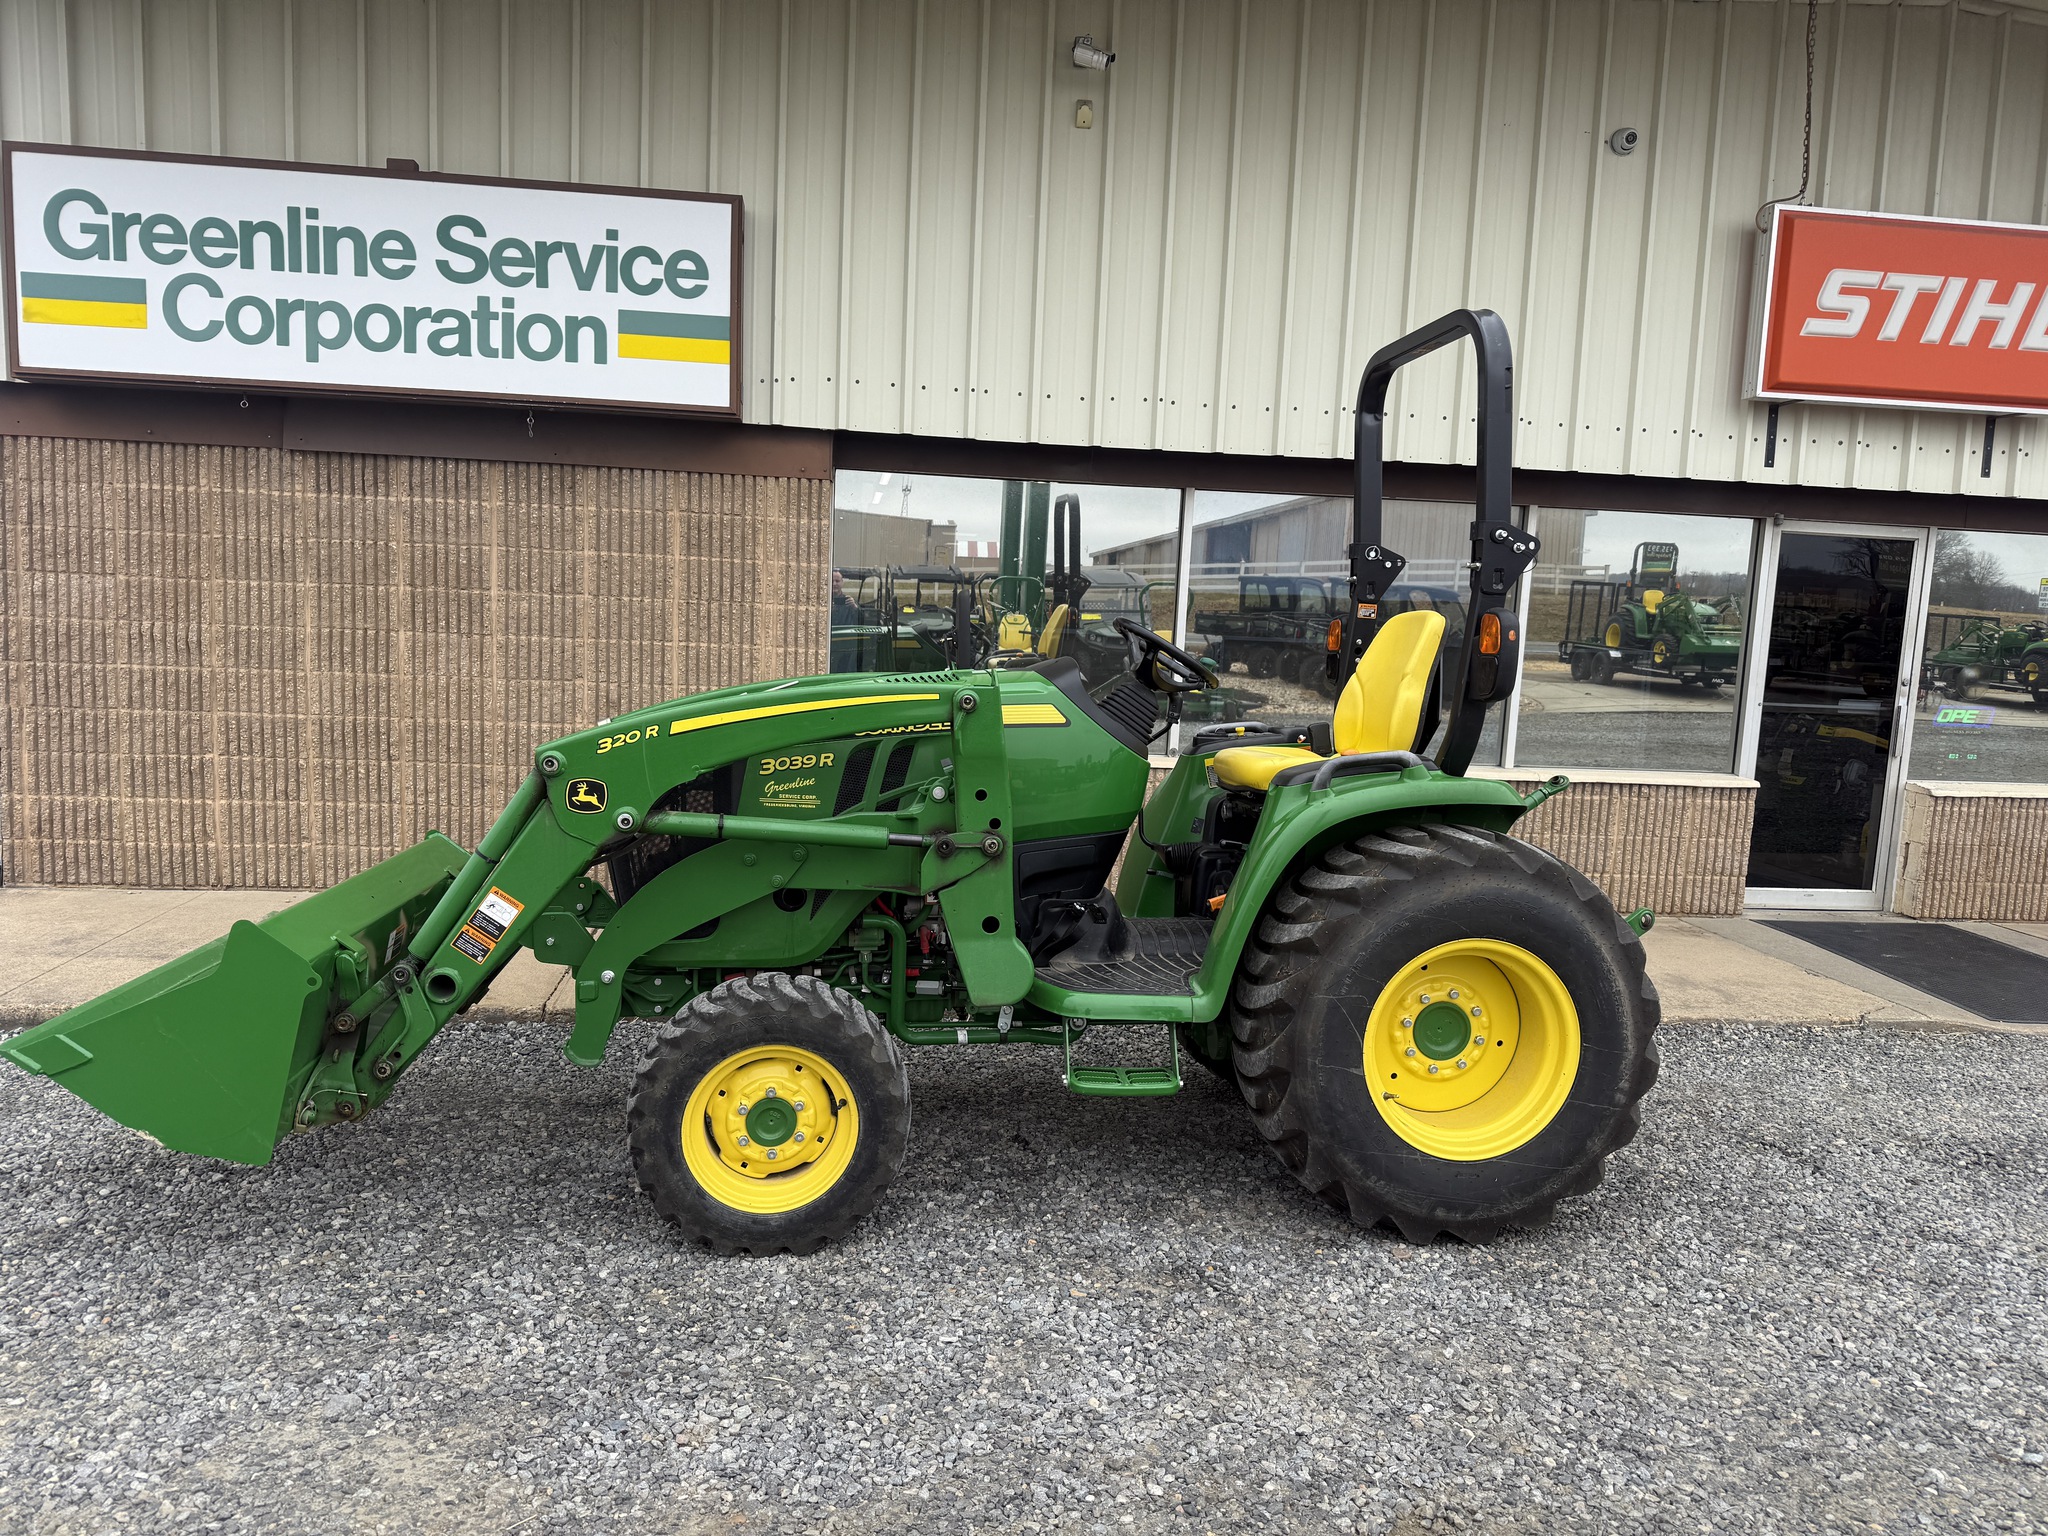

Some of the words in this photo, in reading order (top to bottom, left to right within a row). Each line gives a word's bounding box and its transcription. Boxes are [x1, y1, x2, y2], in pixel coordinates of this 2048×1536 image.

[42, 187, 417, 282] Greenline
[435, 213, 710, 299] Service
[161, 272, 609, 365] Corporation
[596, 729, 642, 754] 320
[645, 725, 659, 740] R
[759, 754, 817, 775] 3039
[819, 752, 835, 768] R
[764, 777, 816, 797] Greenline
[499, 892, 520, 909] WARNING
[470, 930, 493, 948] WARNING
